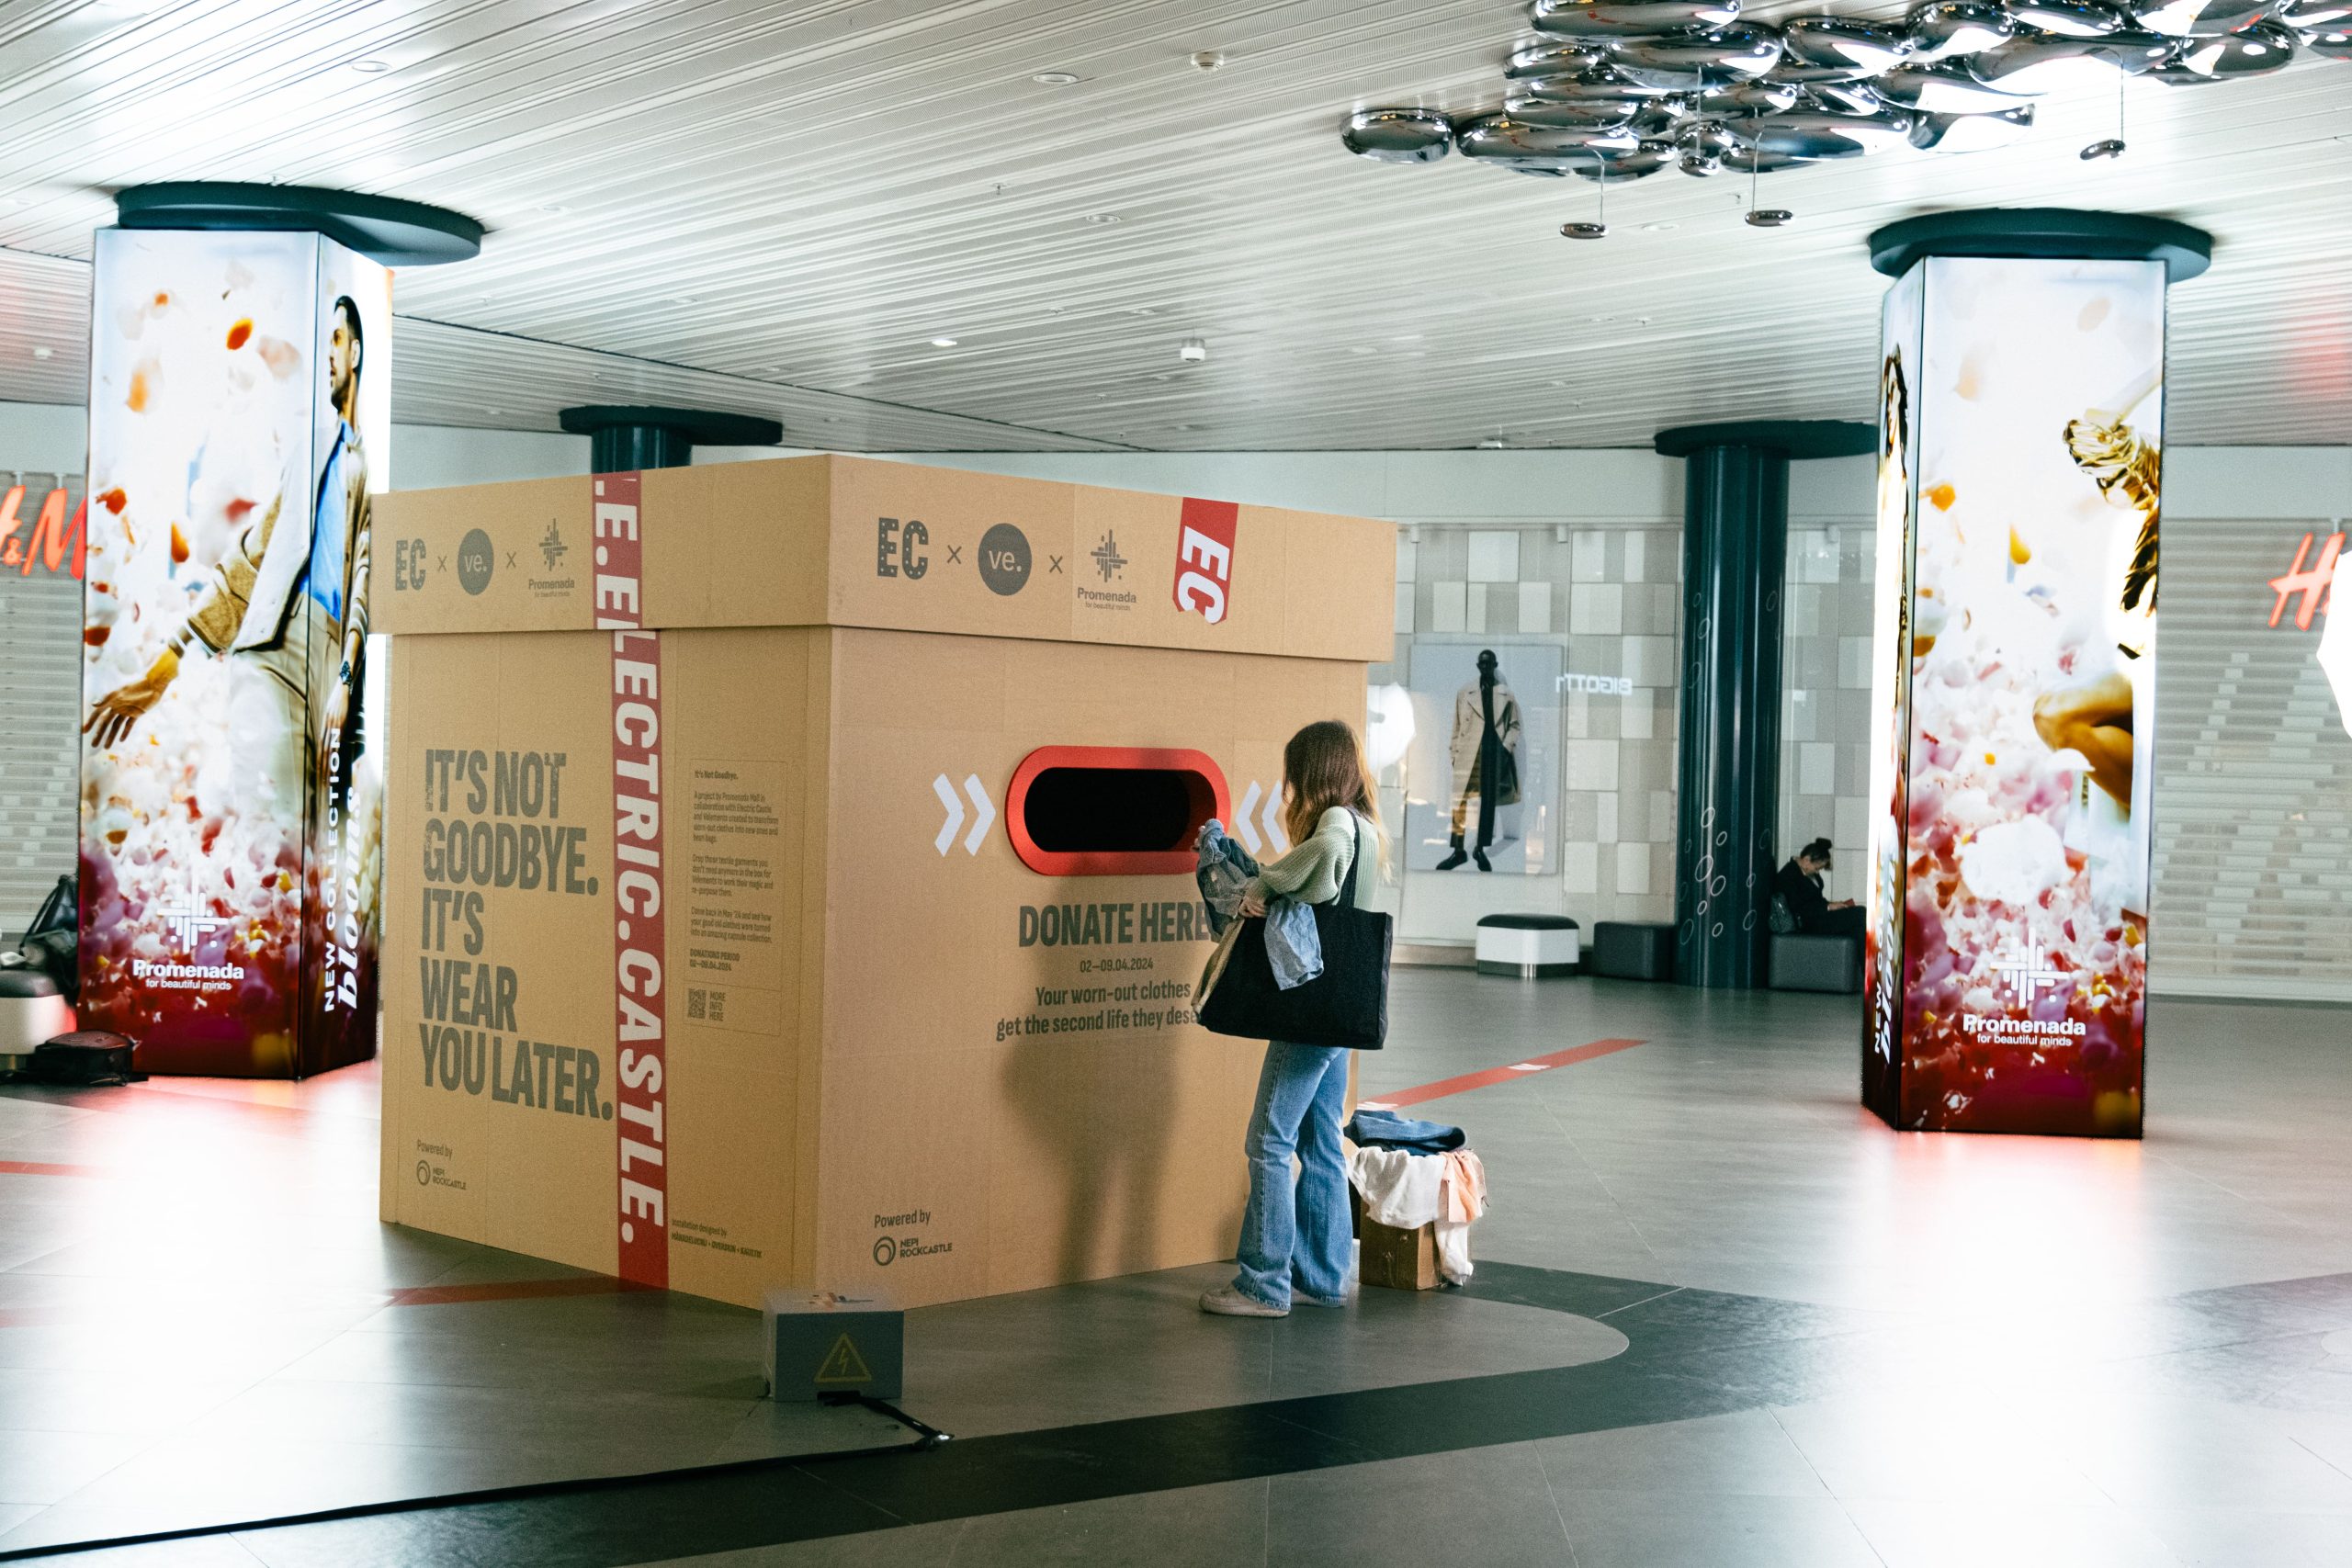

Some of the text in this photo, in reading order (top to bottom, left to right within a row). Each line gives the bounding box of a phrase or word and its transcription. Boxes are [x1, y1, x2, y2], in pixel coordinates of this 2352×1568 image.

[395, 538, 426, 591] EC
[464, 553, 488, 572] ve.
[877, 517, 929, 580] EC
[989, 547, 1023, 573] ve.
[528, 577, 575, 590] Promenada
[1077, 587, 1137, 603] Promenada
[1177, 525, 1230, 626] EC
[424, 749, 567, 818] IT'S NOT
[324, 727, 341, 1012] NEW COLLECTION
[424, 818, 599, 897] GOODBYE.
[337, 786, 361, 1010] blooms
[421, 887, 485, 956] IT'S
[1019, 901, 1211, 947] DONATE HERE
[133, 959, 244, 979] Promenada
[145, 978, 232, 991] for beautiful minds
[419, 956, 518, 1033] WEAR
[1035, 980, 1191, 1007] Your worn-out clothes
[996, 1006, 1197, 1042] get the second life they dese
[1962, 1013, 2086, 1035] Promenada
[1977, 1033, 2073, 1046] for beautiful minds
[419, 1024, 614, 1122] YOU LATER.
[874, 1209, 932, 1228] Powered by
[899, 1243, 953, 1258] ROCKCASTLE
[900, 1237, 919, 1247] NEPI
